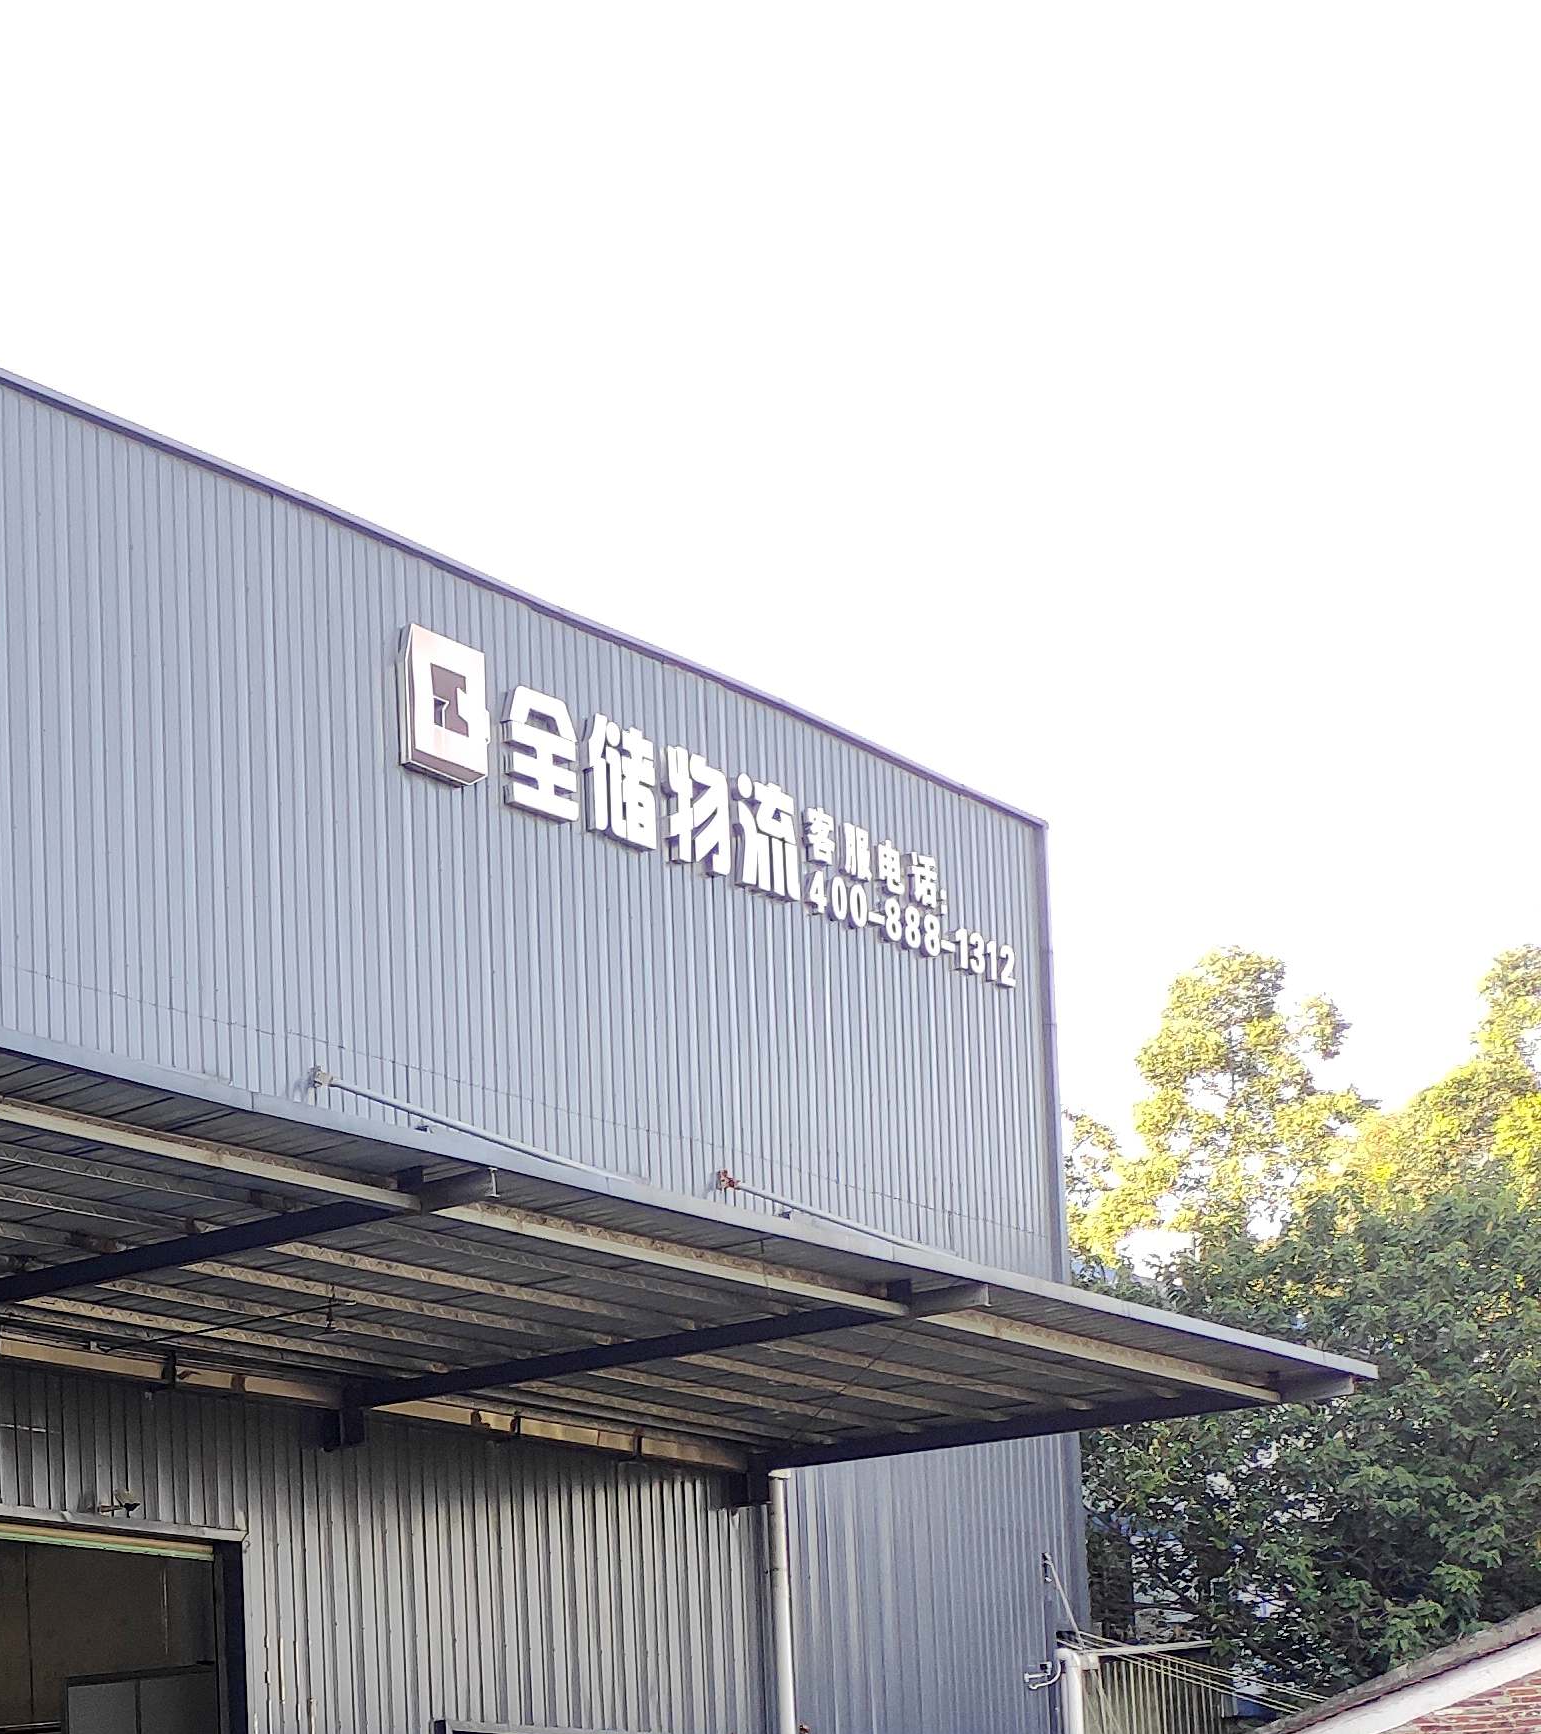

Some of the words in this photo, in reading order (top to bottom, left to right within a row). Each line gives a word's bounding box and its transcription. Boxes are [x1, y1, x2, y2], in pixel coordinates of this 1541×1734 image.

[501, 685, 801, 902] 全储物流
[805, 870, 1016, 988] 400-888-1312
